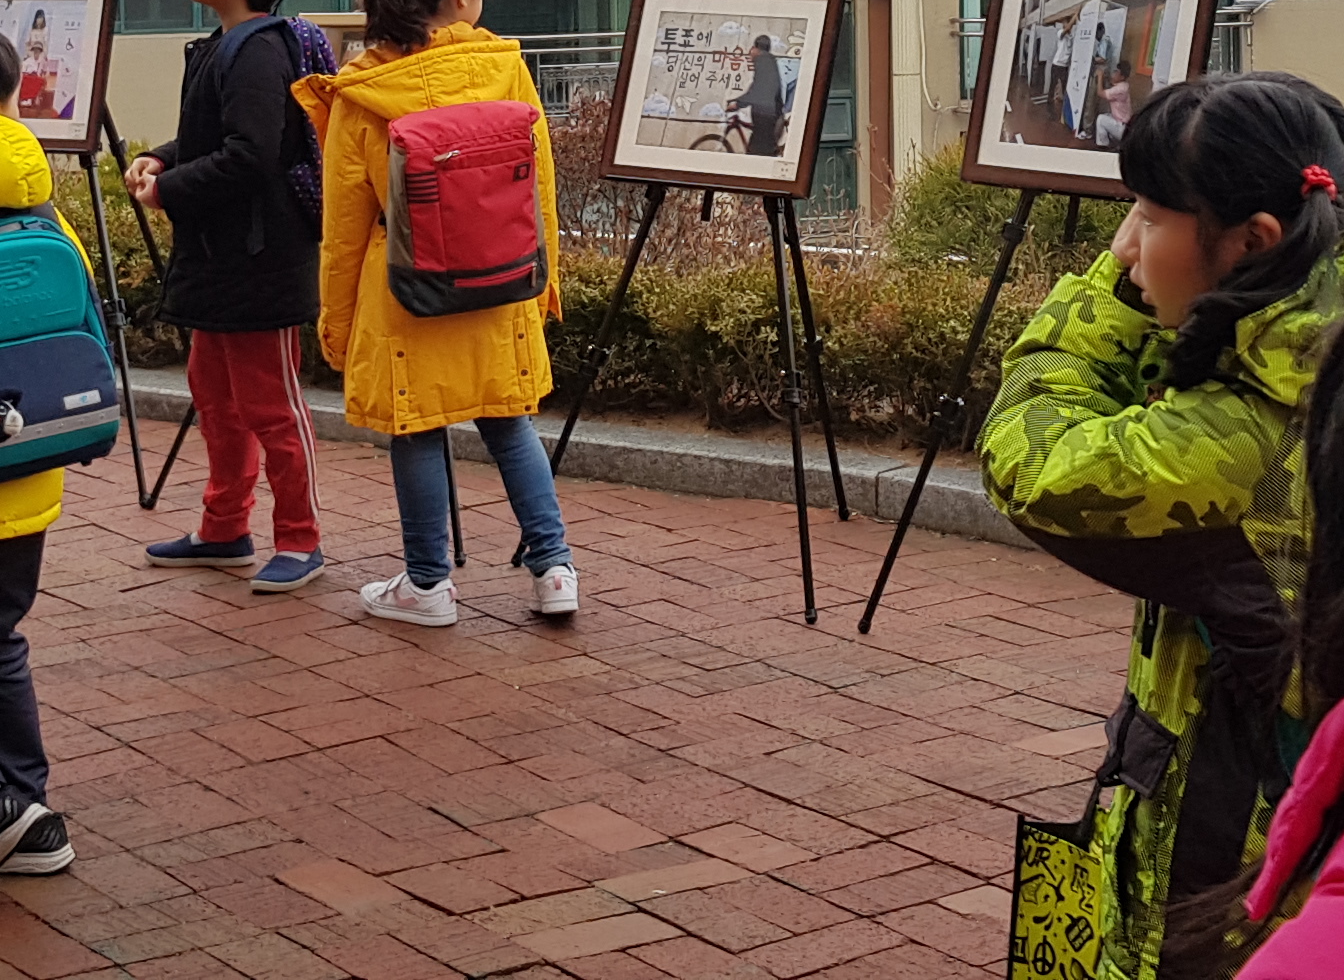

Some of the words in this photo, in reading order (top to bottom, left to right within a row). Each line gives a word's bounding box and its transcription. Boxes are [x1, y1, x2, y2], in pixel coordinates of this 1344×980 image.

[660, 27, 713, 55] 투표에
[666, 54, 707, 73] 당신의
[705, 70, 744, 92] 주세요
